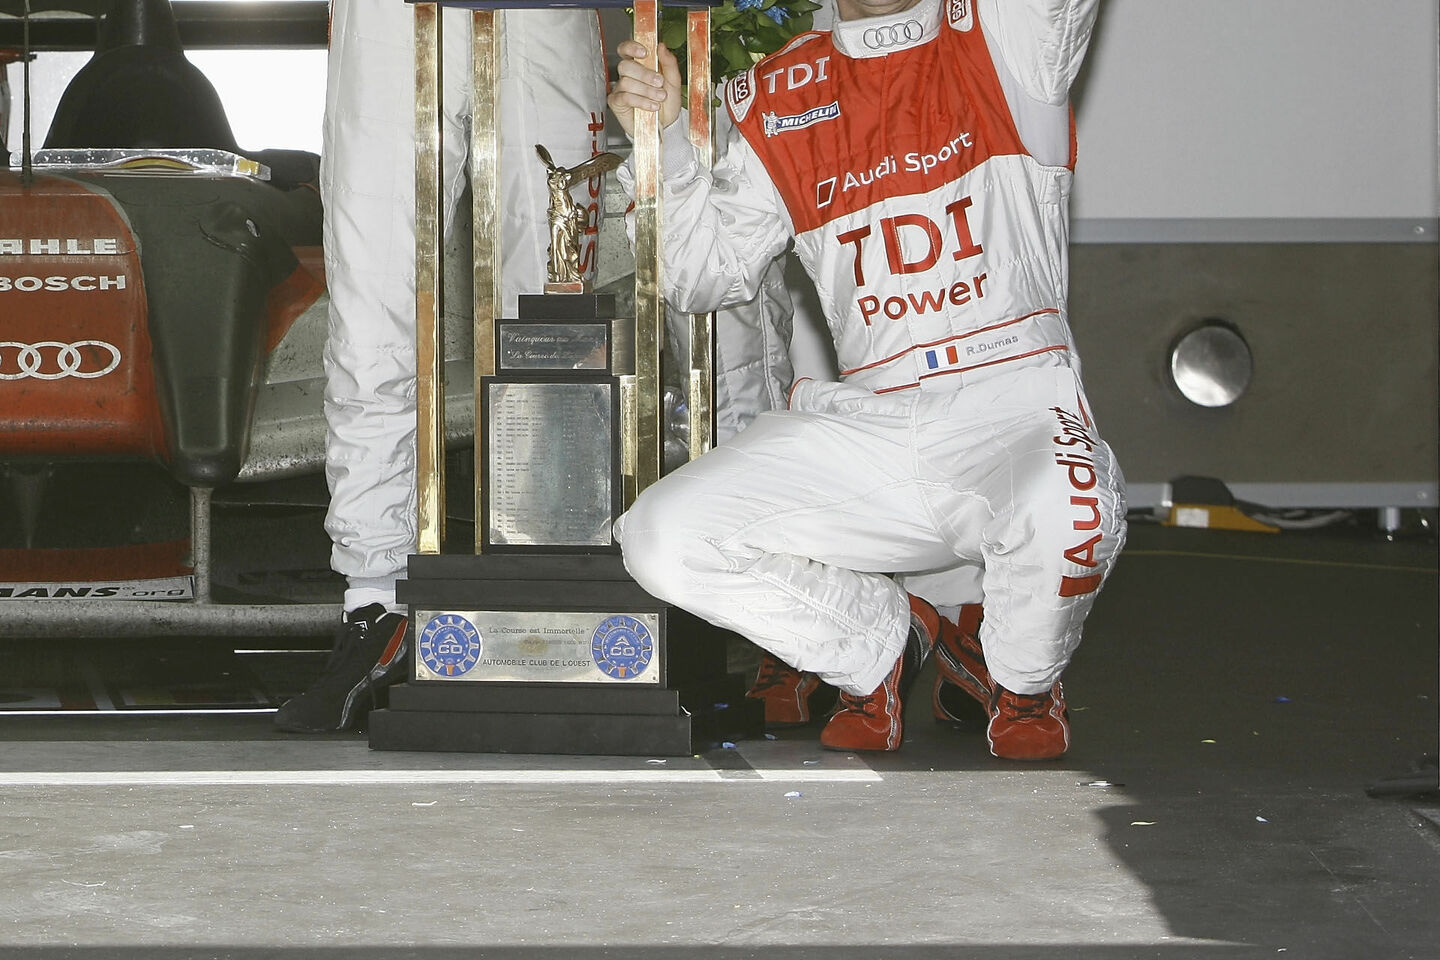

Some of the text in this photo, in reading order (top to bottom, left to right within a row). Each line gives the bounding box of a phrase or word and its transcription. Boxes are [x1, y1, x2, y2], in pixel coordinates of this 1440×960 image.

[763, 56, 830, 94] TDI
[781, 105, 838, 129] MICHELIN
[842, 131, 973, 193] Audi Sport
[836, 195, 983, 287] TDI
[857, 272, 988, 327] Power
[1048, 406, 1103, 568] Audi Sport
[529, 659, 548, 667] CLUB
